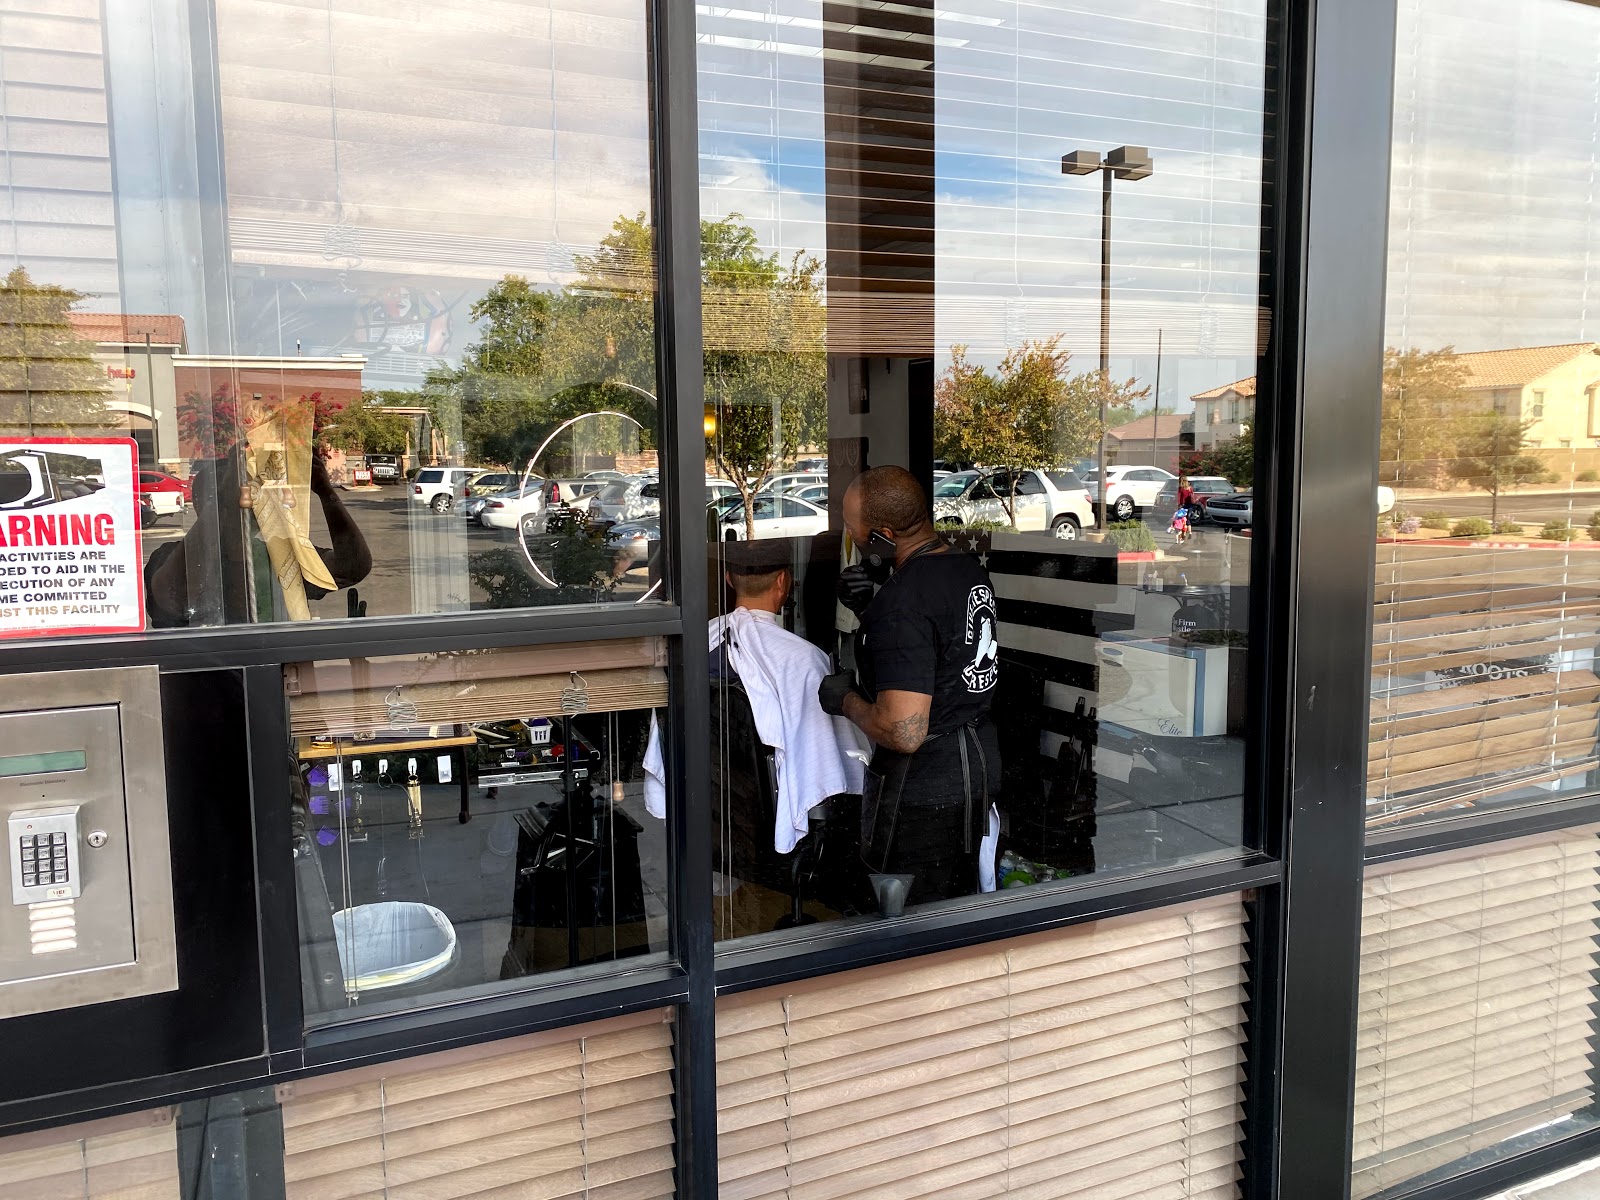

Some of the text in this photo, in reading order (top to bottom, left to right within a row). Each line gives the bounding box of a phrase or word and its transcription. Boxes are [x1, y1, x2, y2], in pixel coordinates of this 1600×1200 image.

[0, 551, 106, 562] ACTIVITIES ARE
[31, 565, 51, 575] TO
[56, 565, 79, 574] AID
[83, 564, 96, 573] IN
[101, 564, 125, 573] THE
[0, 577, 115, 590] ECUTION OF ANY
[23, 591, 107, 602] COMMITTED
[26, 605, 58, 616] THIS
[62, 604, 120, 615] FACILITY
[1178, 618, 1196, 626] Firm
[1158, 718, 1182, 736] Elite
